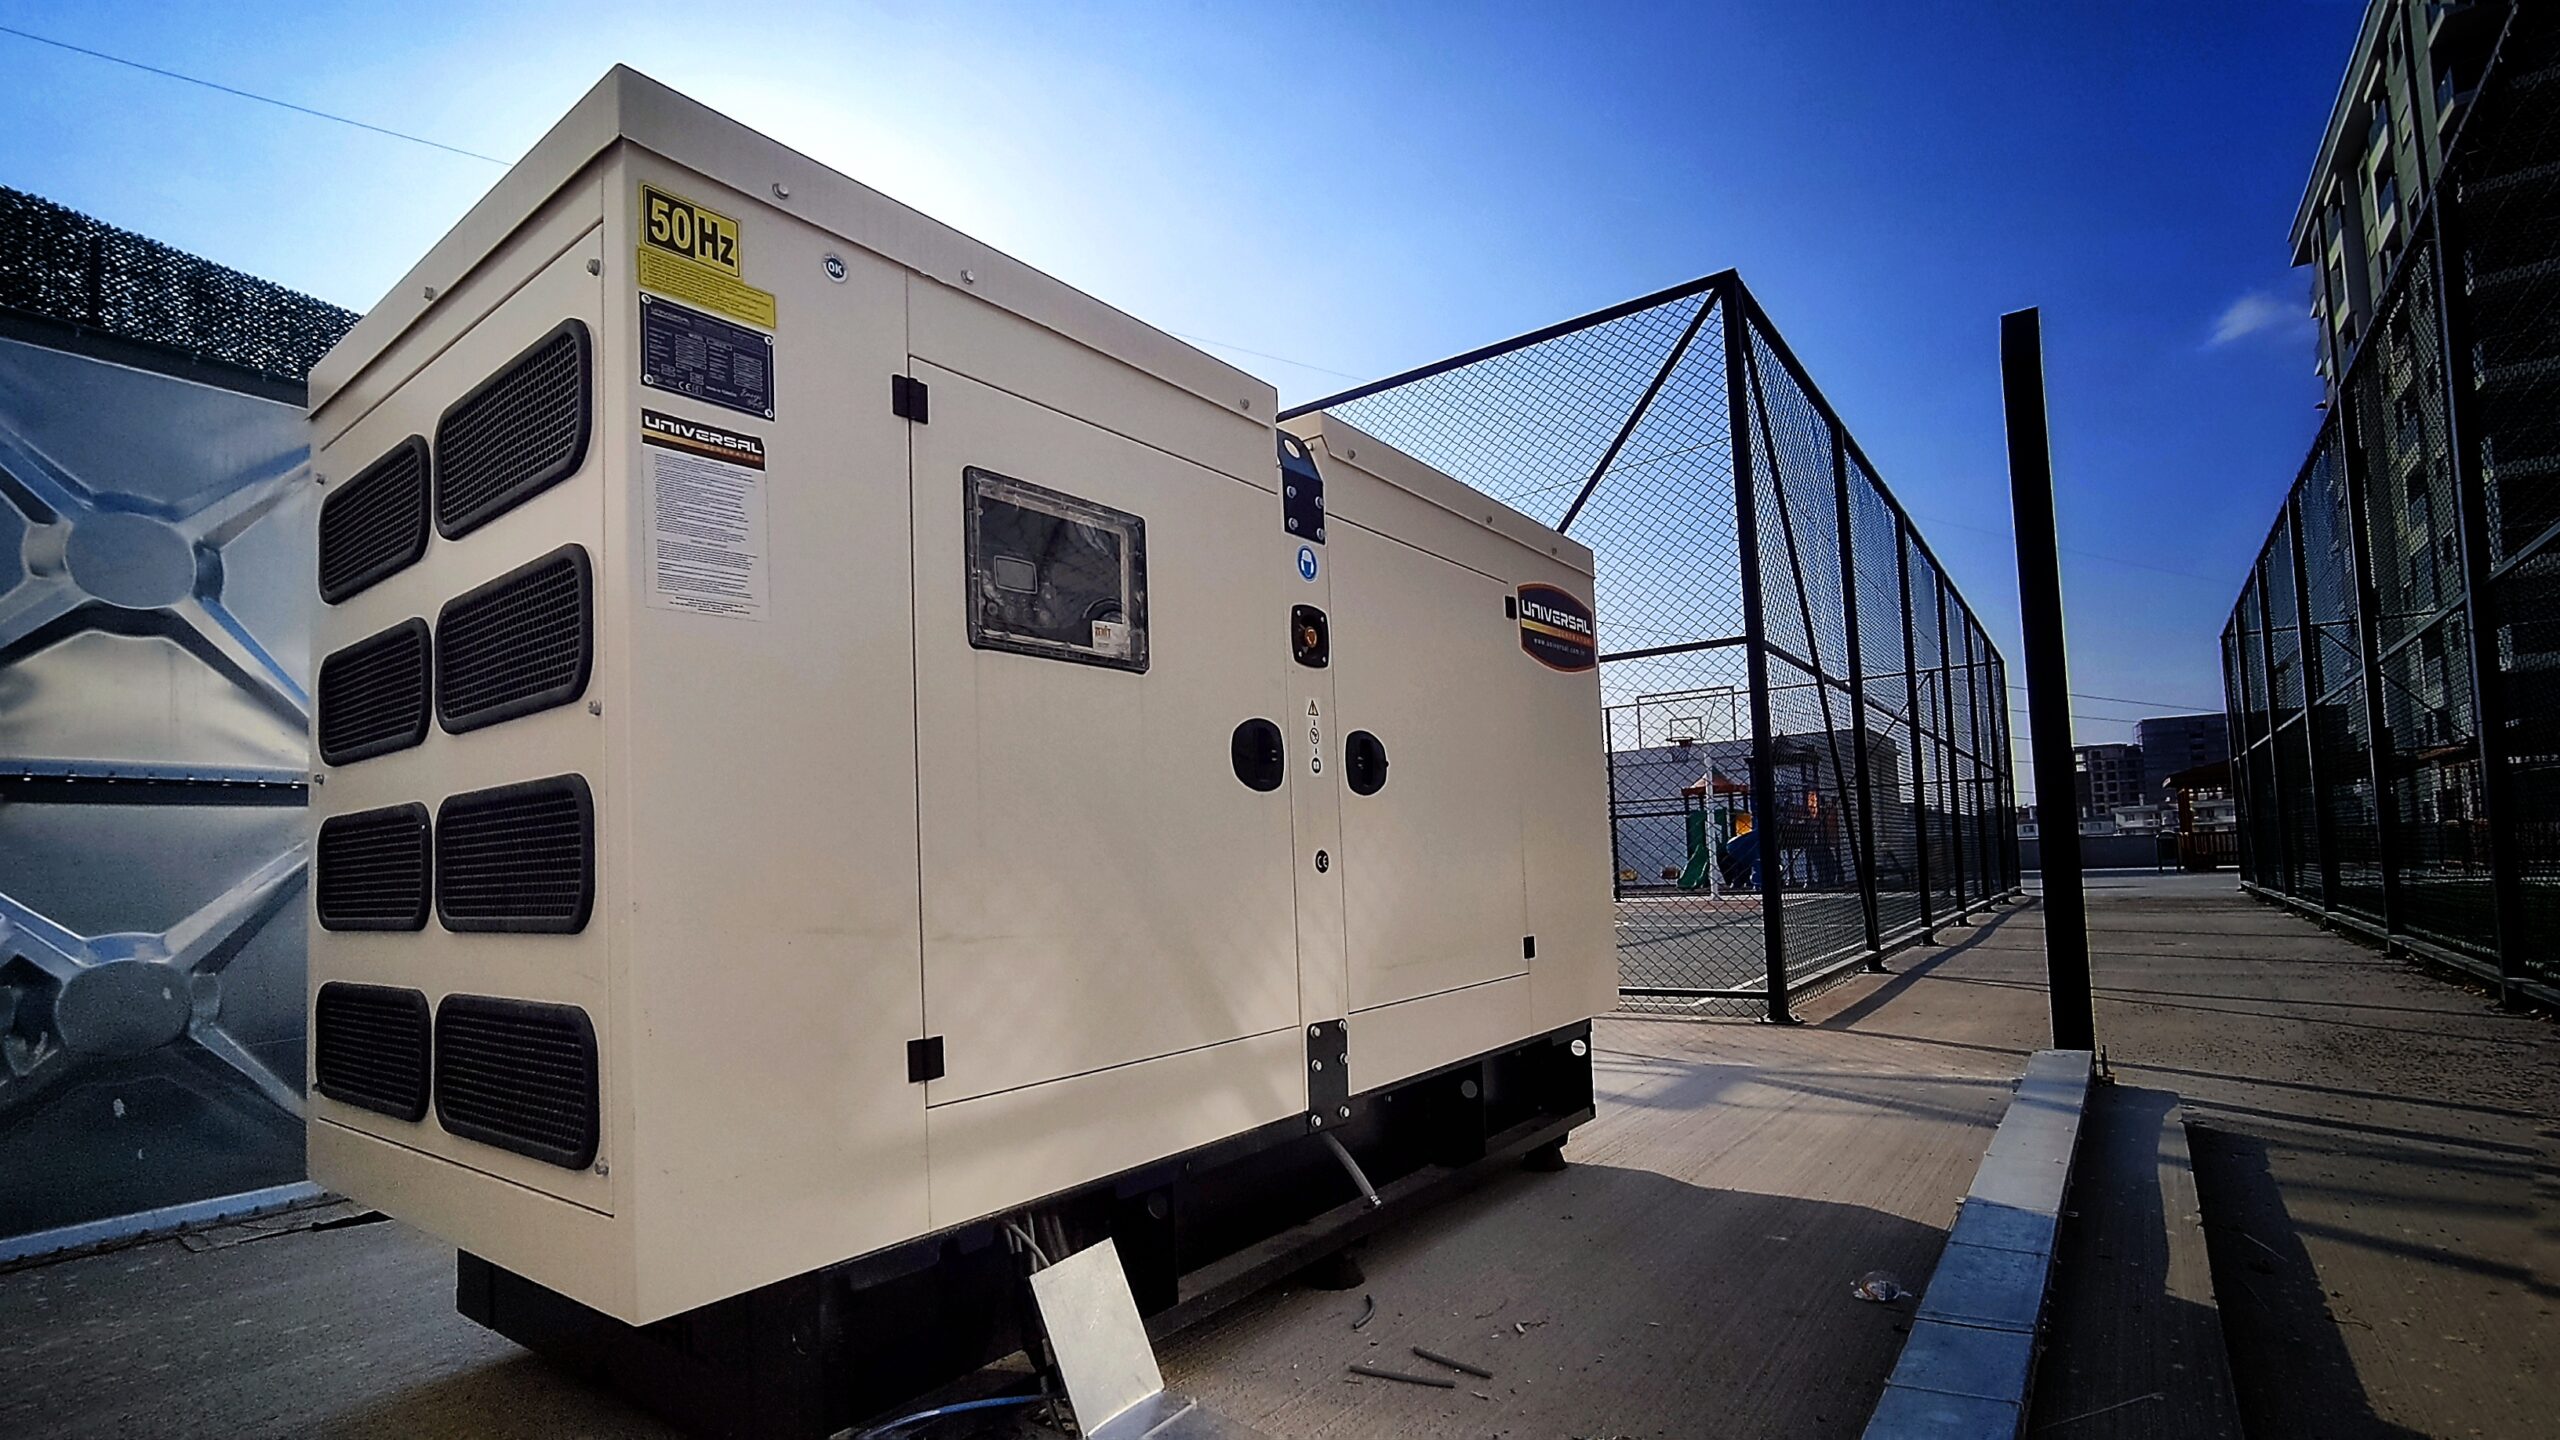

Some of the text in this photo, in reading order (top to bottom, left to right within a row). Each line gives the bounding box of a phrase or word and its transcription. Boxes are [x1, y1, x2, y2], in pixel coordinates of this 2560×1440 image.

[650, 197, 735, 267] 50Hz
[828, 261, 843, 276] OK
[644, 415, 763, 454] UNIVERSAL
[1521, 599, 1592, 635] UNIVERSAL
[1317, 855, 1328, 868] CE
